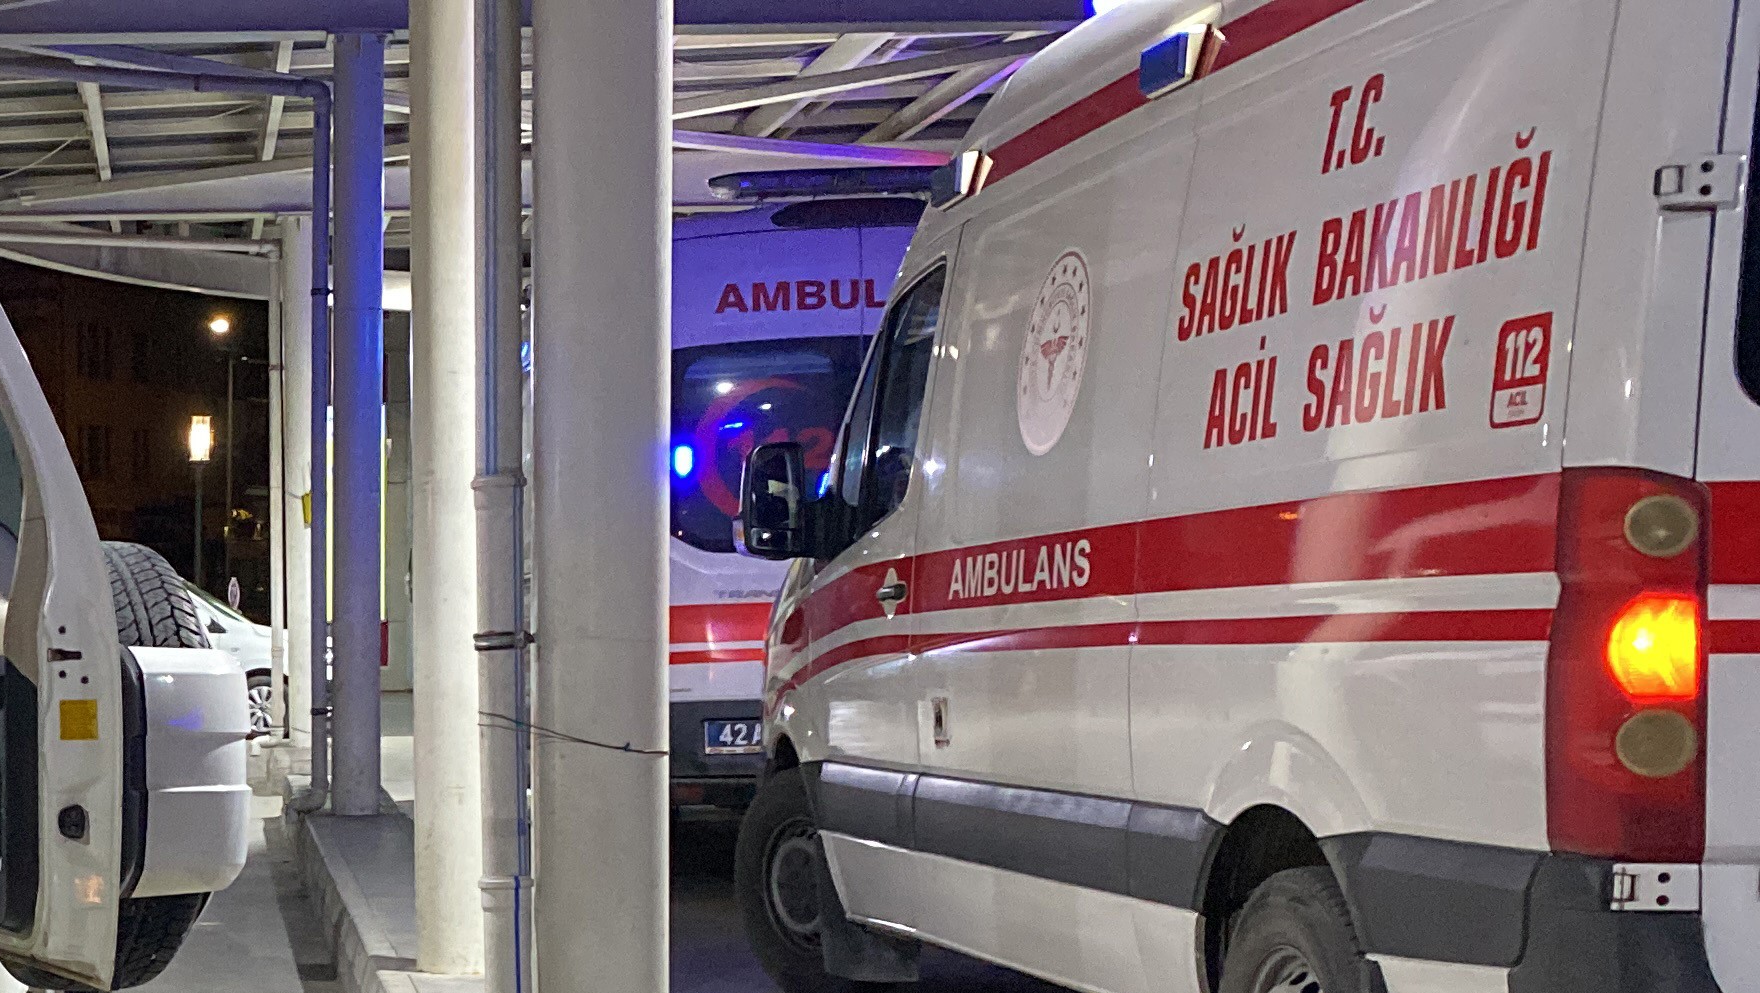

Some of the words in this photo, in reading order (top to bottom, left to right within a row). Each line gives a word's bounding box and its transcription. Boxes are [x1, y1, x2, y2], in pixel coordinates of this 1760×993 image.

[1321, 73, 1387, 175] T.C.
[1177, 223, 1298, 342] SAĞLIK
[1312, 126, 1552, 306] BAKANLIĞI
[714, 278, 887, 315] AMBUL
[1203, 335, 1278, 450] ACİL
[1302, 303, 1456, 433] SAĞLIK
[1504, 326, 1544, 381] 112
[948, 539, 1092, 600] AMBULANS
[719, 722, 749, 746] 42
